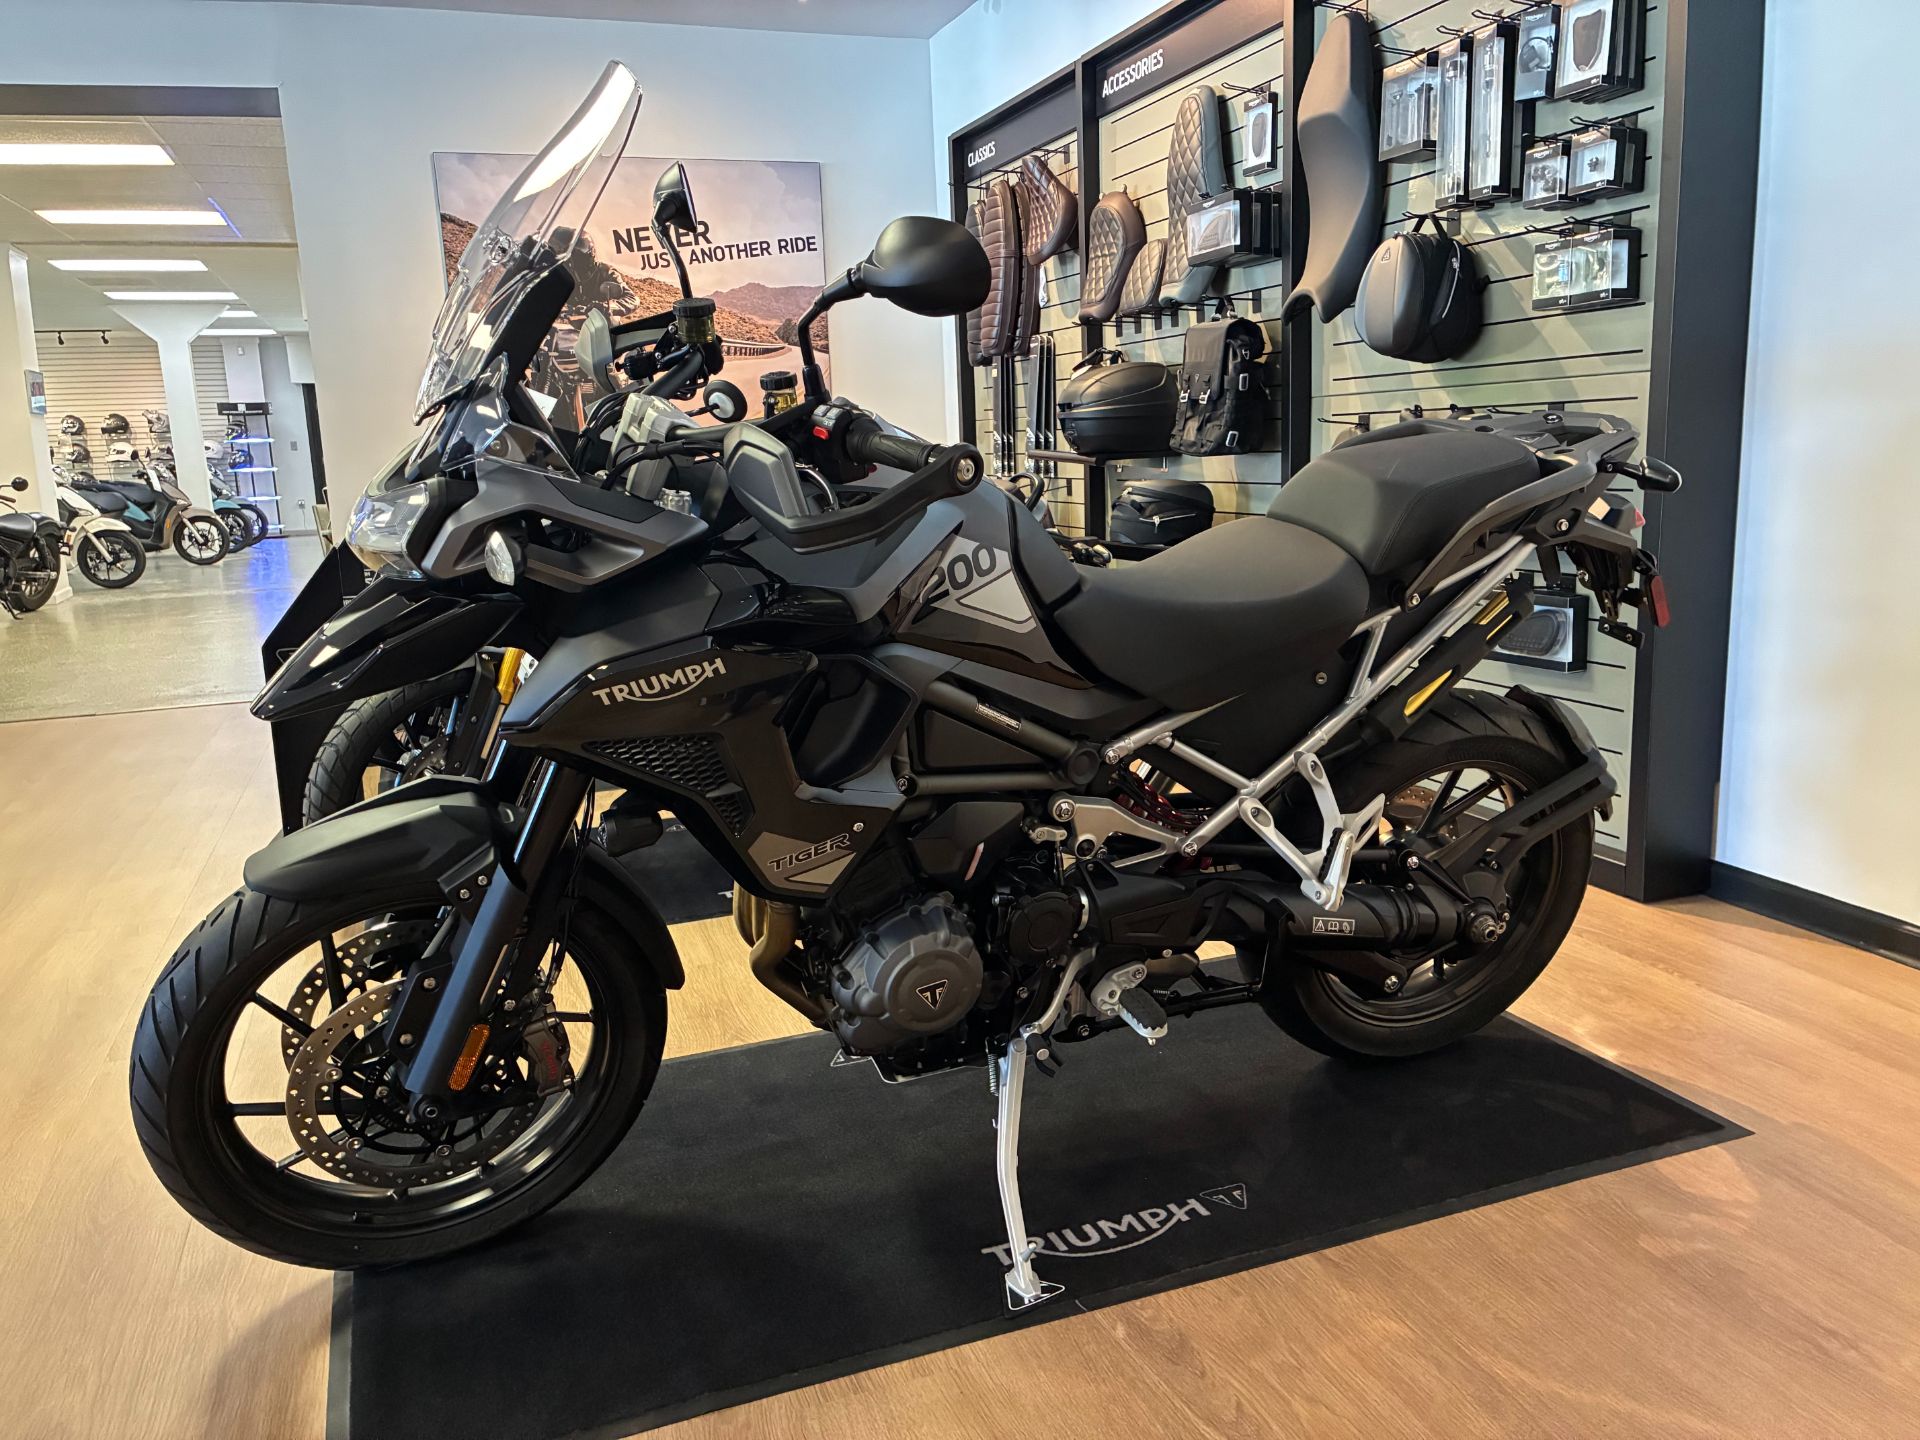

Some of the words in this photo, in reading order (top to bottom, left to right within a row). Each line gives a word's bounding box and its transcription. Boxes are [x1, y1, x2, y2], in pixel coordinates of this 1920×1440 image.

[1102, 48, 1164, 98] ACCESSORIES
[967, 140, 996, 168] CLASSICS
[640, 251, 681, 270] JUS
[689, 240, 772, 265] ANOTHER
[777, 236, 818, 255] RIDE
[592, 657, 727, 706] TRIUMPH
[768, 833, 850, 872] TIGER
